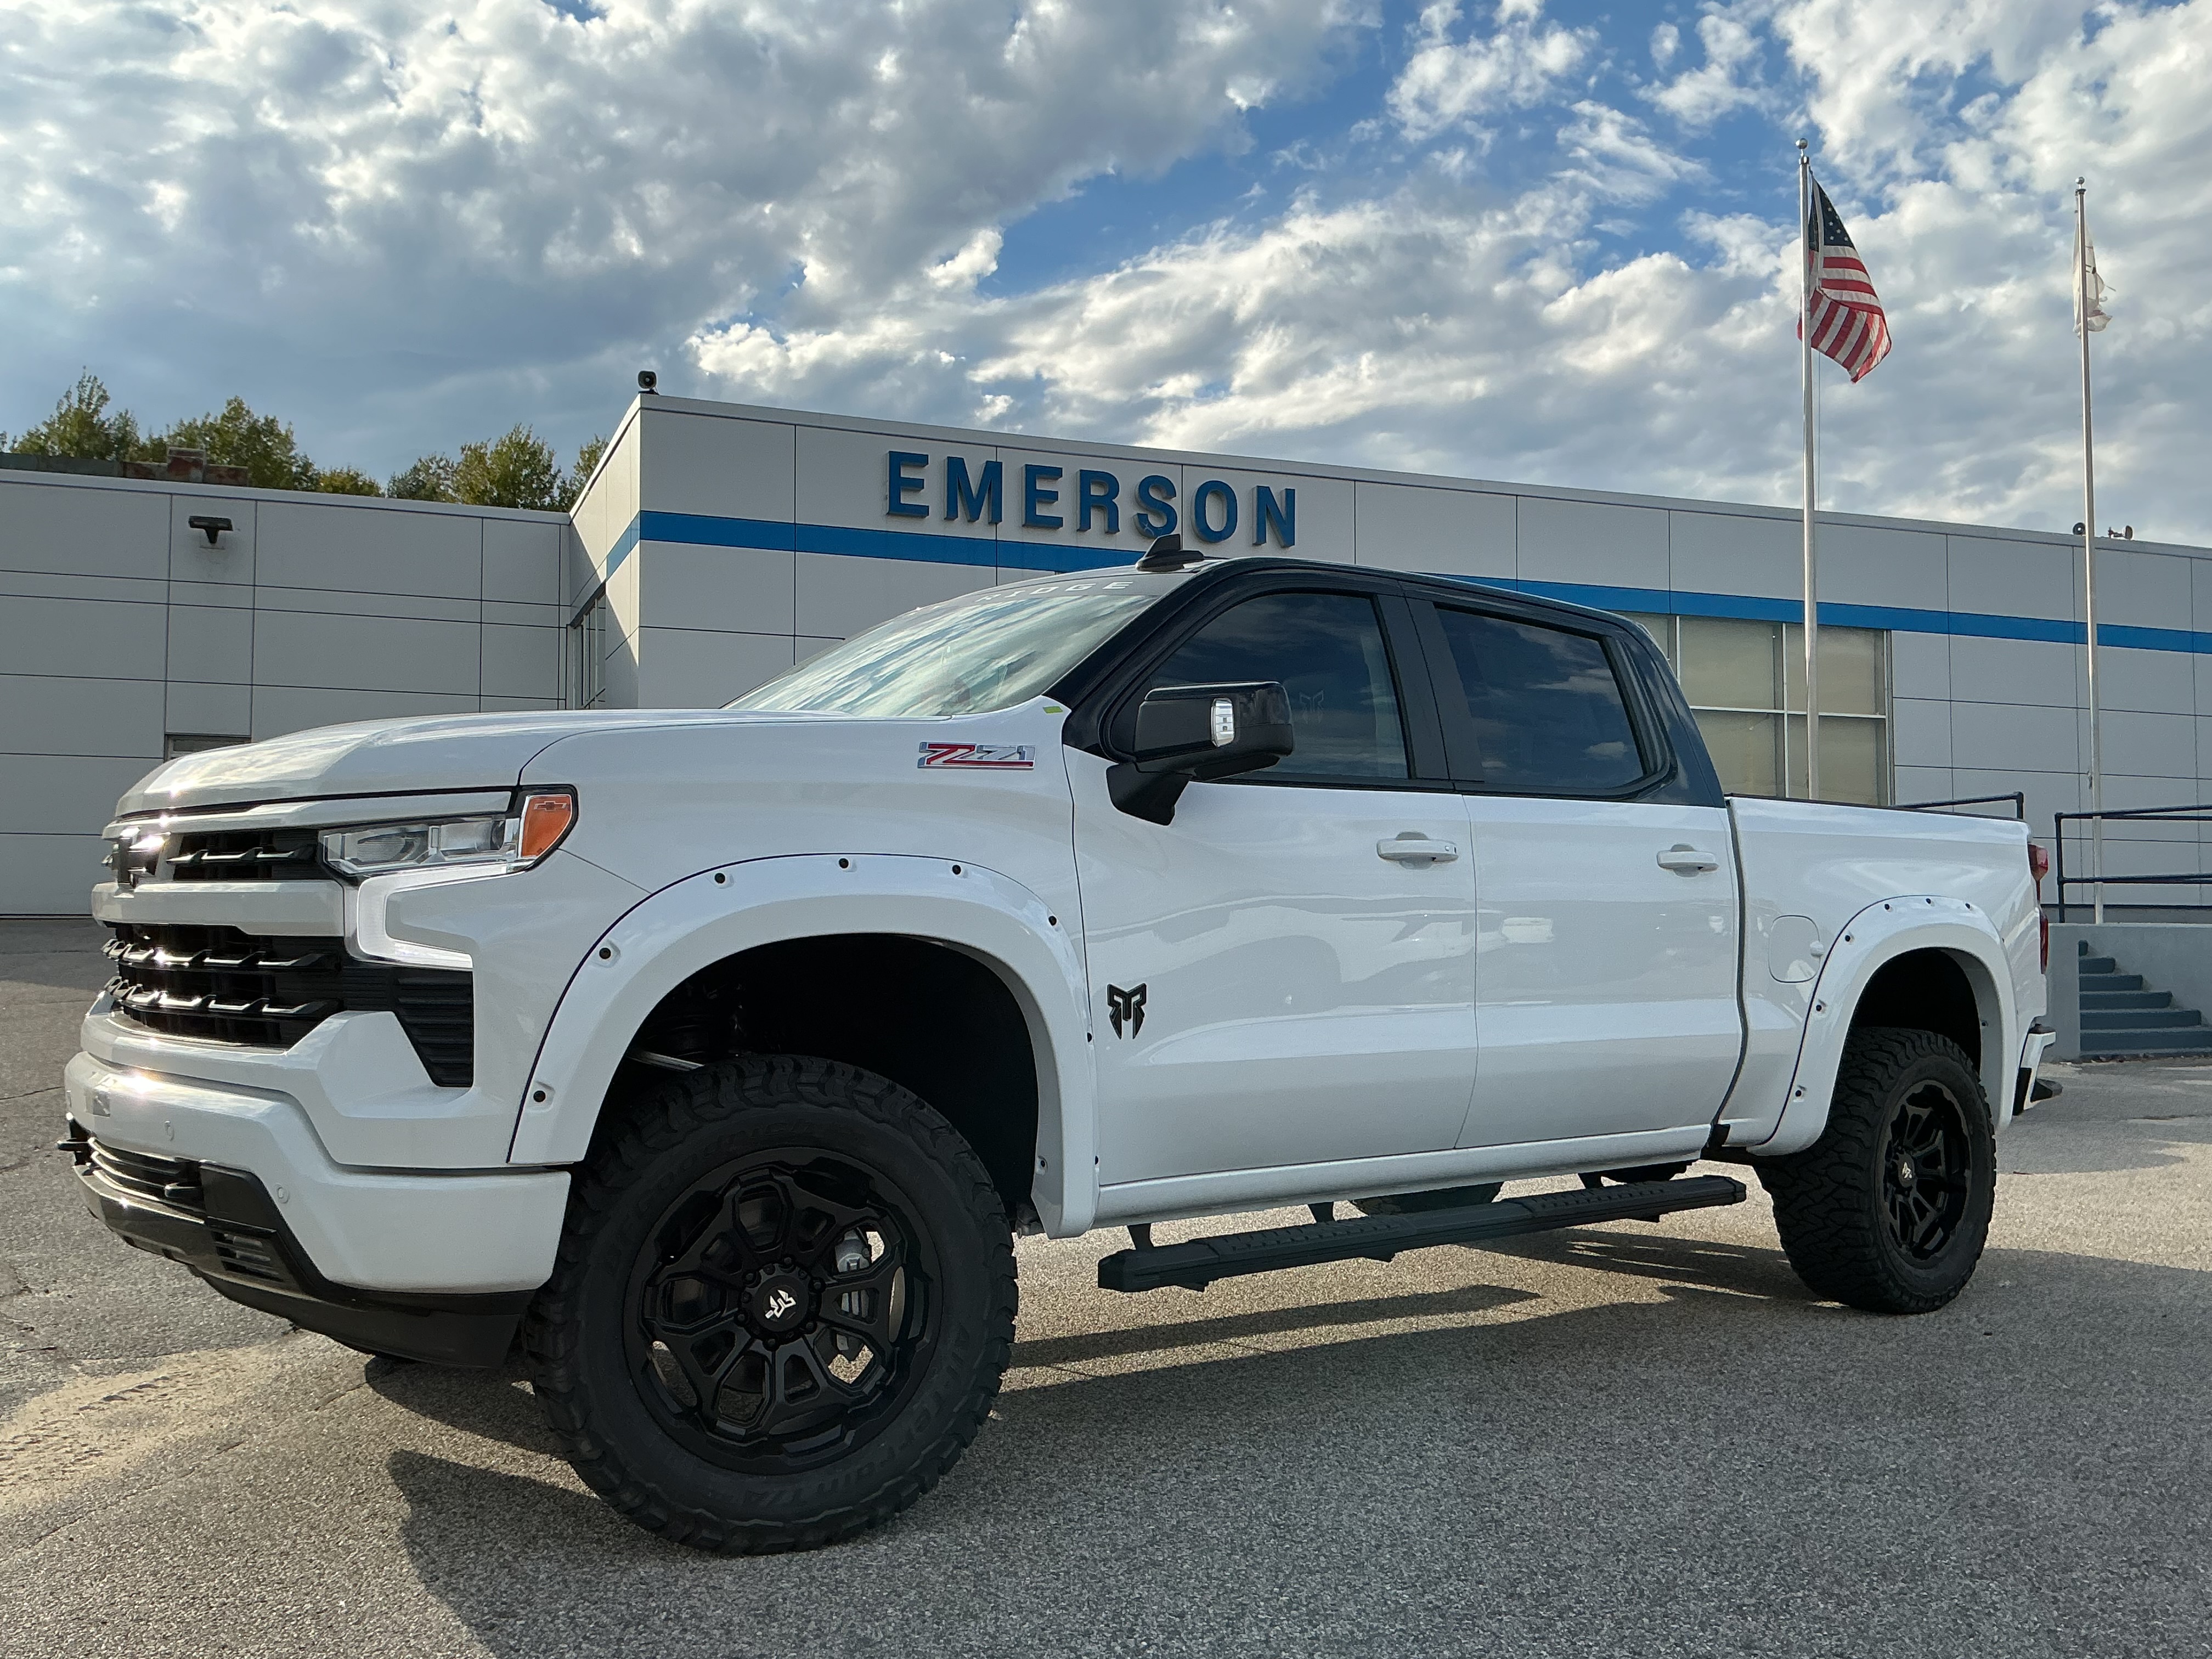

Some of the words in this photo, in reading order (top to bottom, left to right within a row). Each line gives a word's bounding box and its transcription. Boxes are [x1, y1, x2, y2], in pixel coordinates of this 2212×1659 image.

[885, 450, 1296, 548] EMERSON
[973, 581, 1133, 602] RIDGE
[917, 742, 1036, 769] Z71
